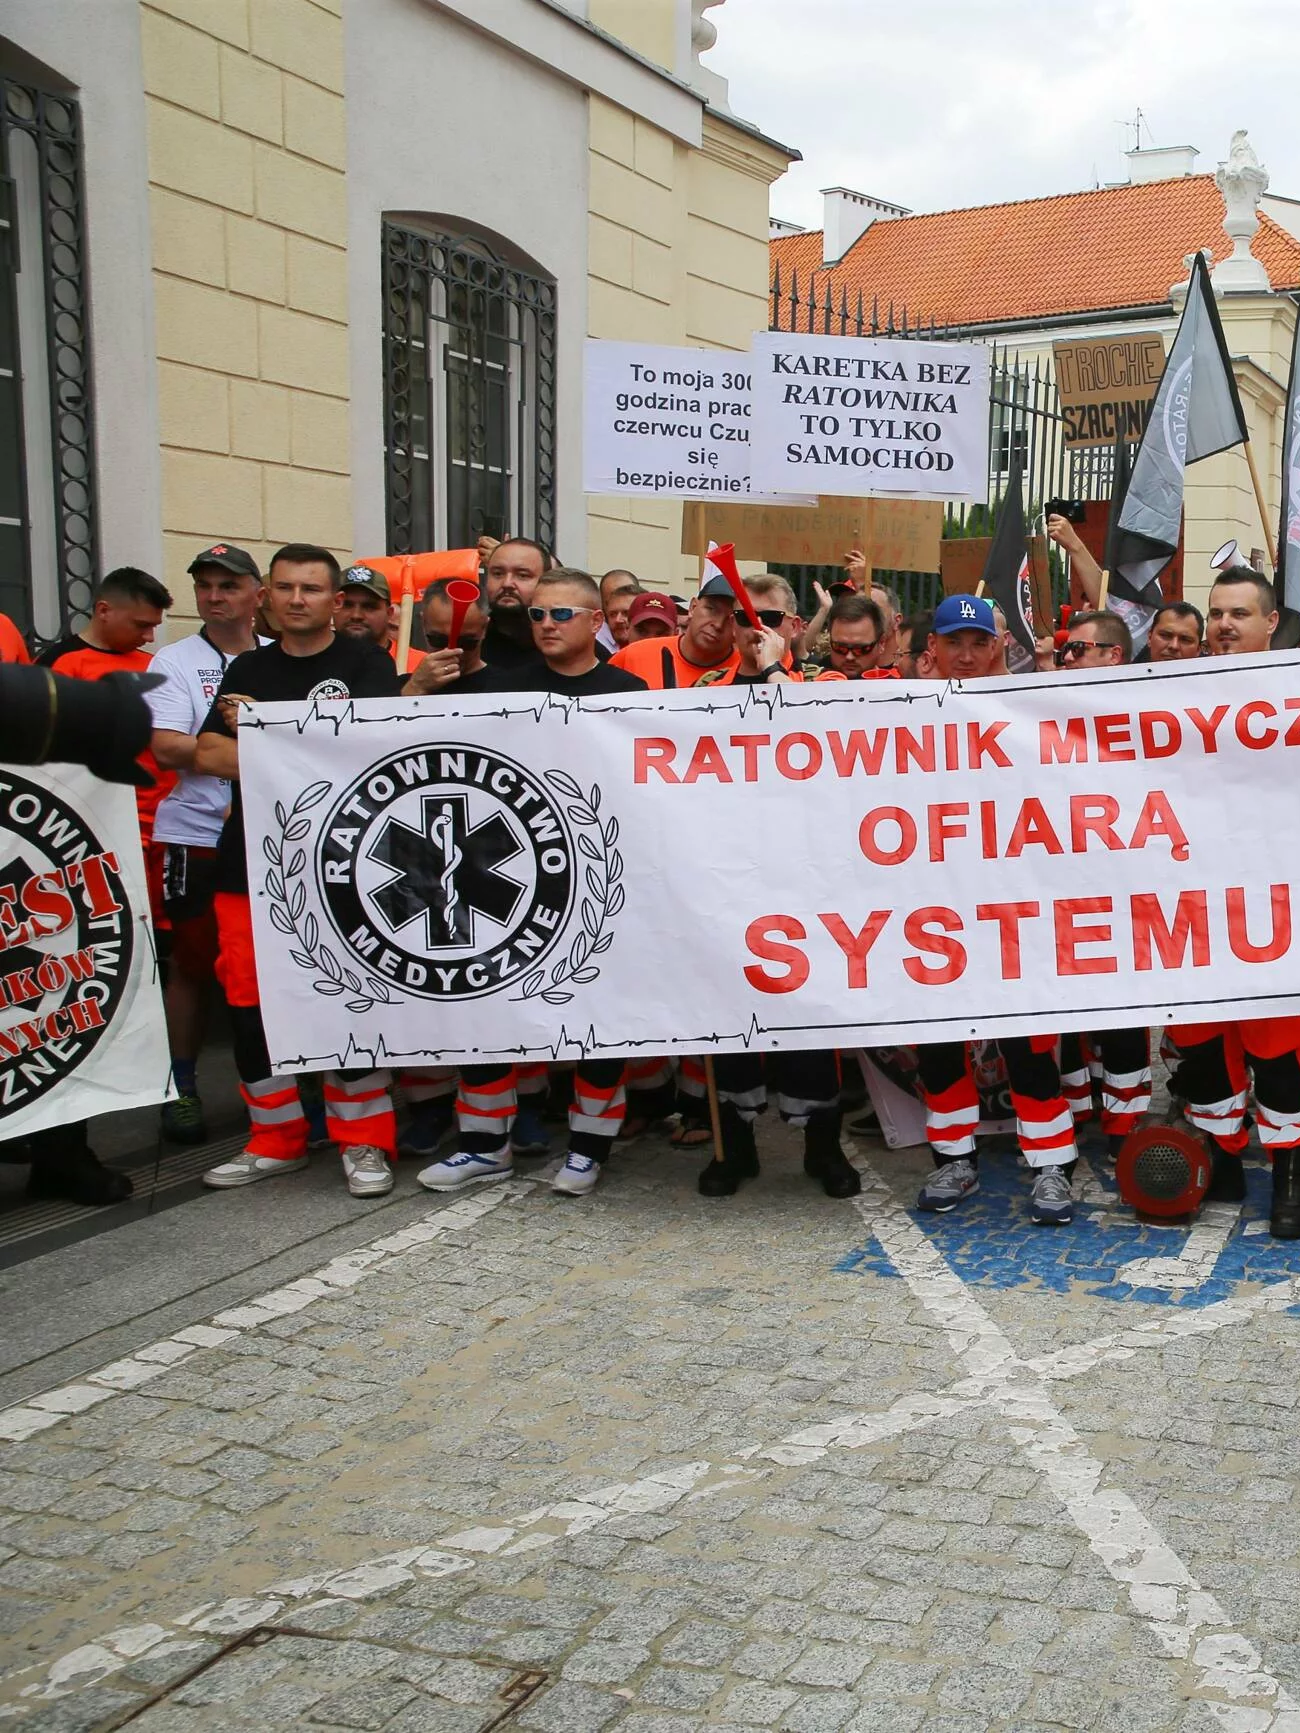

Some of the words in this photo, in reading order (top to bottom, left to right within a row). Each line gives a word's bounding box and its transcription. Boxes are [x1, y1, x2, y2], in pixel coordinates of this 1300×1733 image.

[630, 364, 656, 383] To
[662, 370, 714, 392] moja
[772, 353, 908, 382] KARETKA
[917, 362, 971, 385] BEZ
[616, 392, 700, 414] godzina
[781, 384, 958, 414] RATOWNIKA
[614, 418, 701, 439] czerwcu
[709, 422, 751, 447] Czu
[800, 414, 839, 436] TO
[849, 417, 941, 442] TYLKO
[687, 448, 719, 469] się
[786, 443, 954, 472] SAMOCHÓD
[960, 600, 976, 619] LA
[634, 720, 1013, 785] RATOWNIK
[325, 752, 567, 884] RATOWNICTWO
[858, 790, 1190, 867] OFIARĄ
[348, 903, 560, 991] MEDYCZNE
[743, 883, 1293, 995] SYSTEMU
